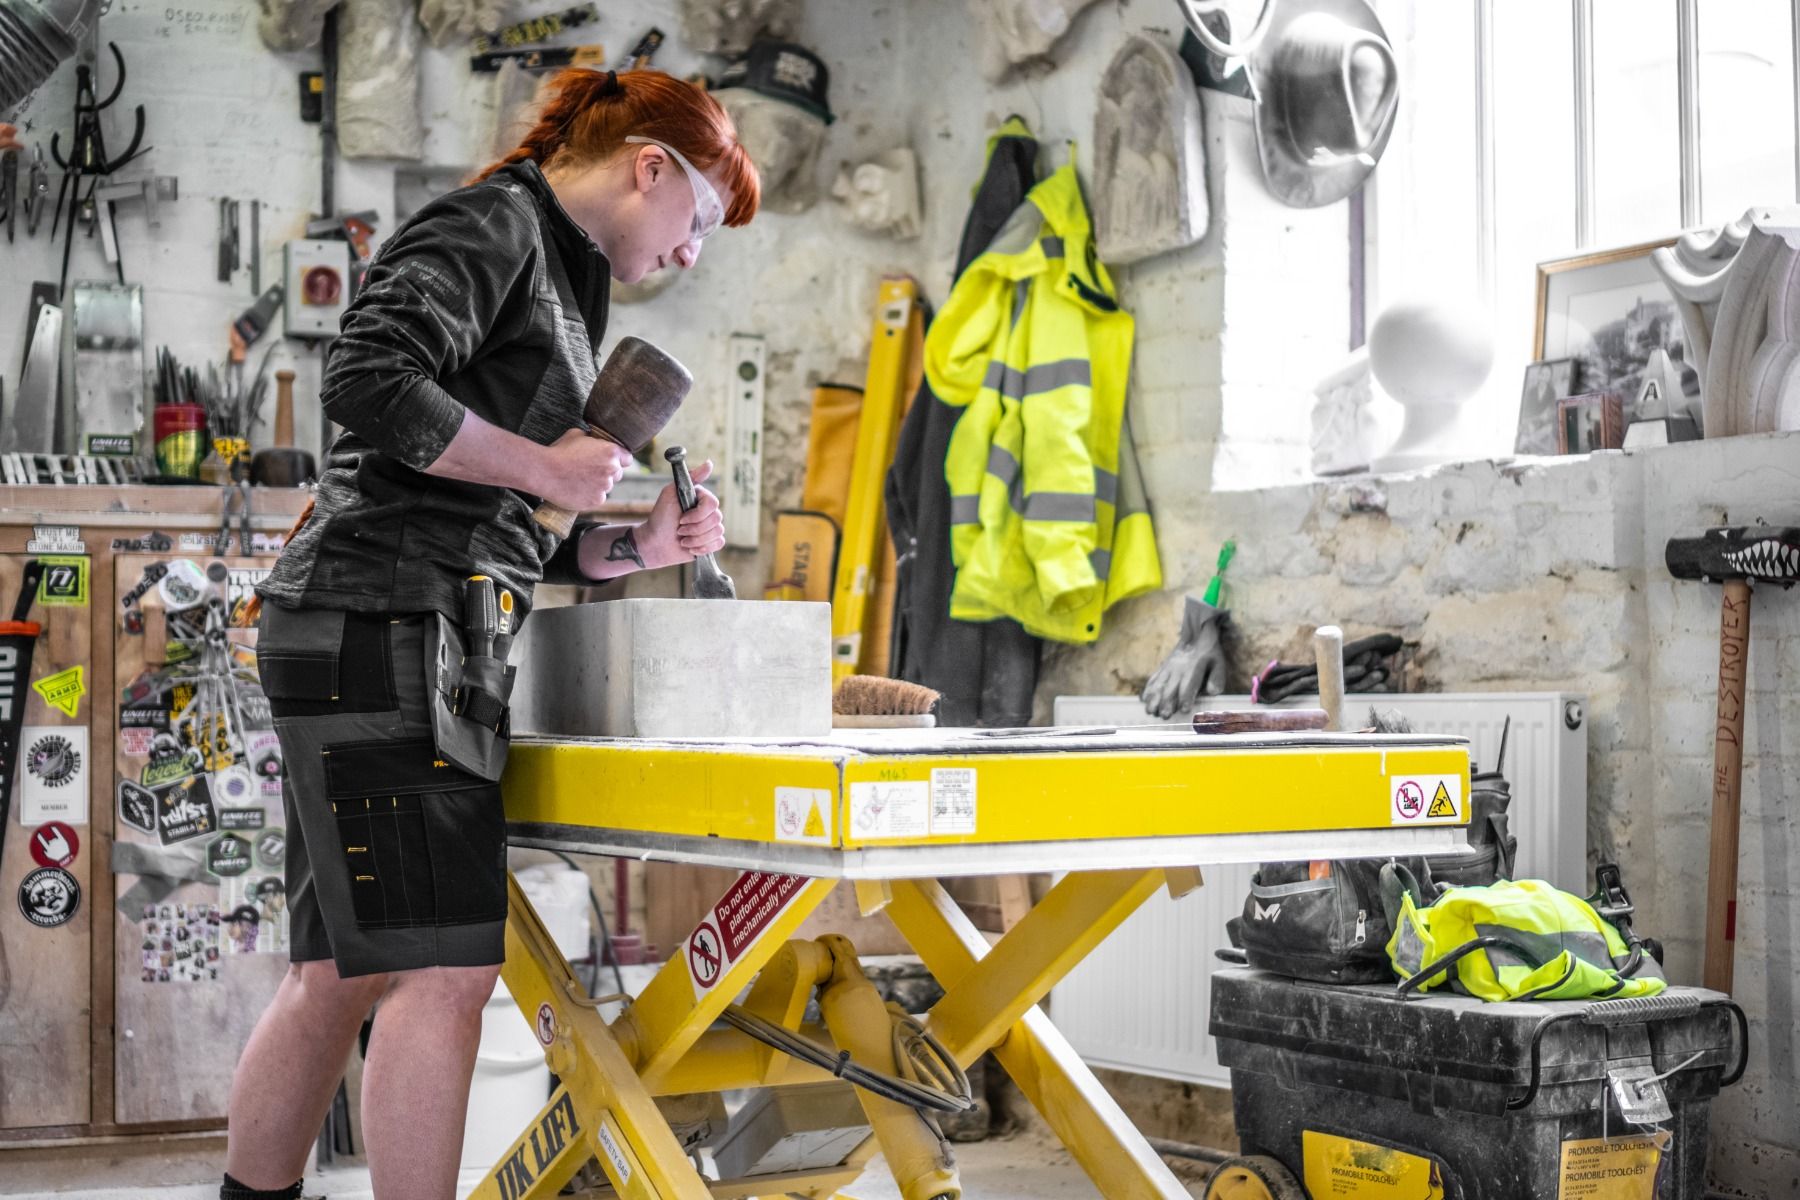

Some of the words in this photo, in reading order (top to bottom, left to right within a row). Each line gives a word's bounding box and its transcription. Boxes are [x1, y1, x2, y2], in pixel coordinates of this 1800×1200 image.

[36, 528, 63, 537] TRUST
[65, 528, 79, 537] ME
[28, 542, 53, 551] STONE
[56, 542, 83, 551] MASON
[793, 541, 811, 583] STAB
[1716, 595, 1747, 747] DESTROYER
[121, 709, 165, 718] UNILITE
[43, 774, 75, 788] SOCIAL
[1715, 765, 1728, 797] THE
[167, 824, 196, 838] STABILA
[718, 907, 730, 921] Do
[730, 889, 744, 908] not
[729, 893, 760, 934] platform
[759, 872, 781, 898] unles
[733, 892, 779, 948] mechanically
[778, 873, 800, 897] locke
[529, 1091, 580, 1176] LIFT
[600, 1128, 619, 1162] SAFETY
[1568, 1144, 1609, 1157] PROMOBILE
[1332, 1167, 1365, 1181] PROMOBILE
[1366, 1173, 1398, 1185] TOOLCHEST
[1565, 1170, 1606, 1182] PROMOBILE
[1608, 1166, 1646, 1178] TOOLCHEST
